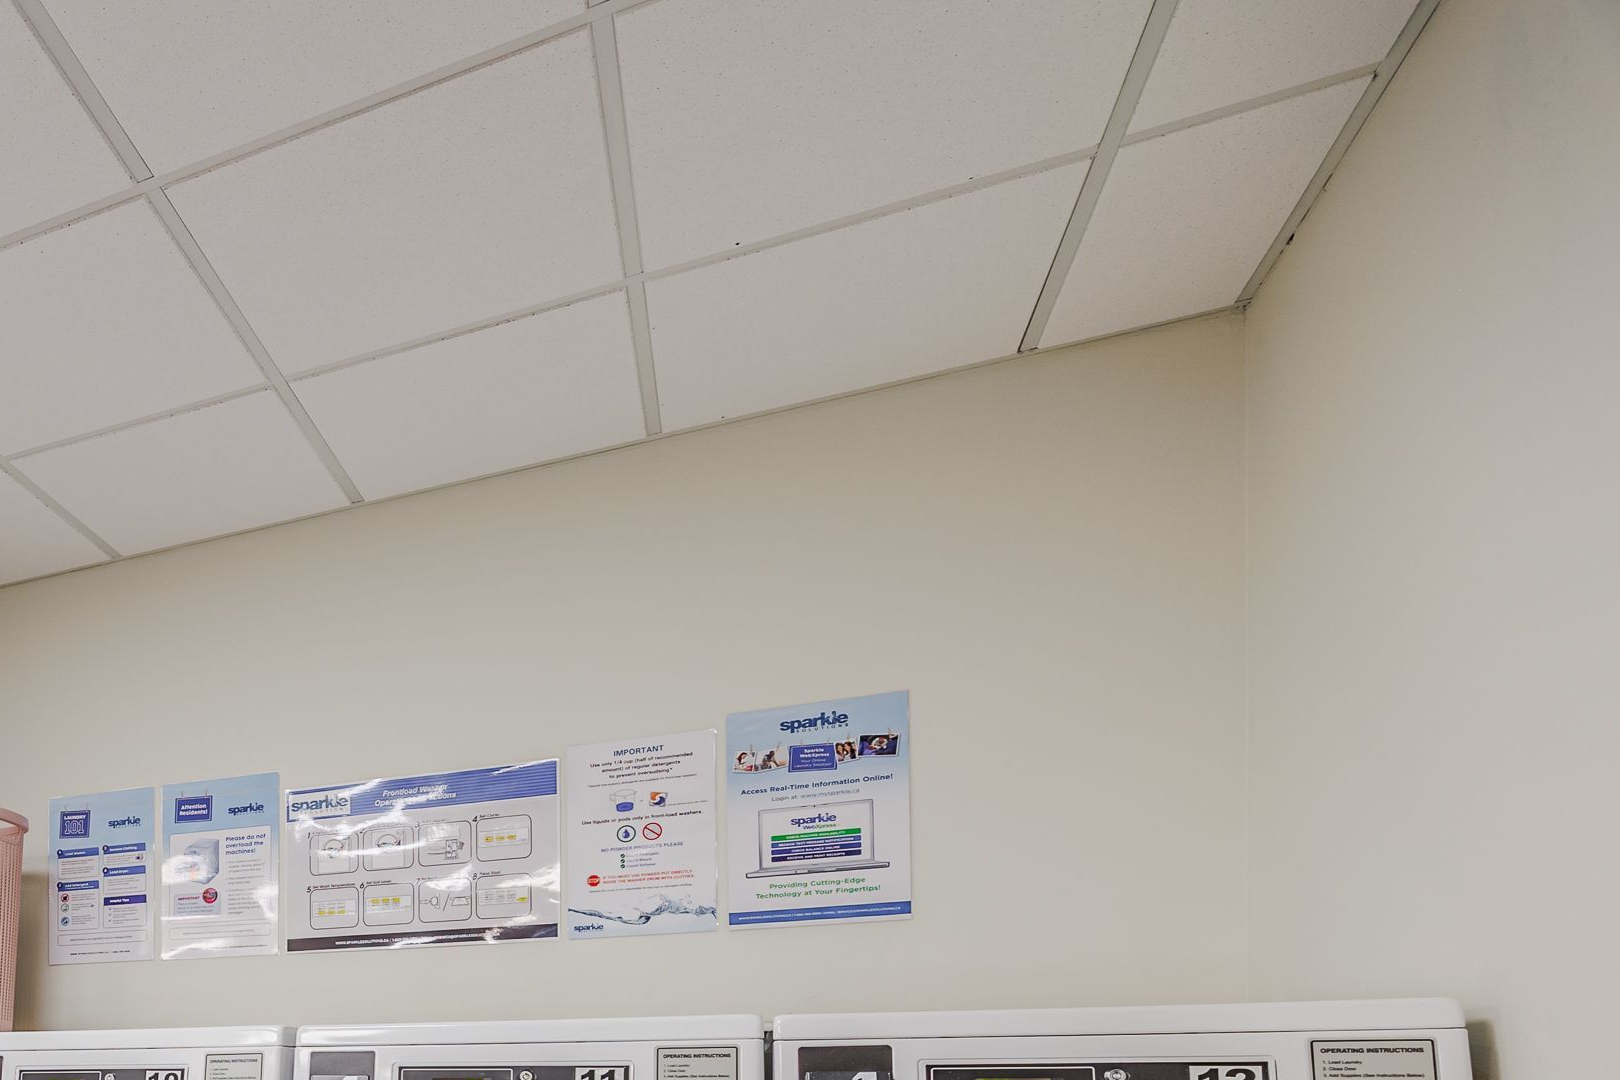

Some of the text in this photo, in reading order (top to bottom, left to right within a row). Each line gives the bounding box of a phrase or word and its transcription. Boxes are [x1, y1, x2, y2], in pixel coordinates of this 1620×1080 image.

[796, 723, 849, 733] SOLUTIONS
[614, 744, 664, 757] IMPORTANT
[654, 752, 693, 760] recommended
[652, 760, 681, 768] detergents
[770, 783, 810, 792] Real-Time
[812, 778, 860, 788] Information
[863, 773, 893, 782] Online!
[382, 786, 418, 797] Frontload
[772, 795, 790, 803] Login
[64, 820, 84, 835] 101
[225, 841, 253, 849] overload
[769, 877, 866, 890] Providing Cutting-Edge
[756, 889, 801, 900] Technology
[815, 888, 833, 896] Your
[836, 885, 881, 895] Fingertips!
